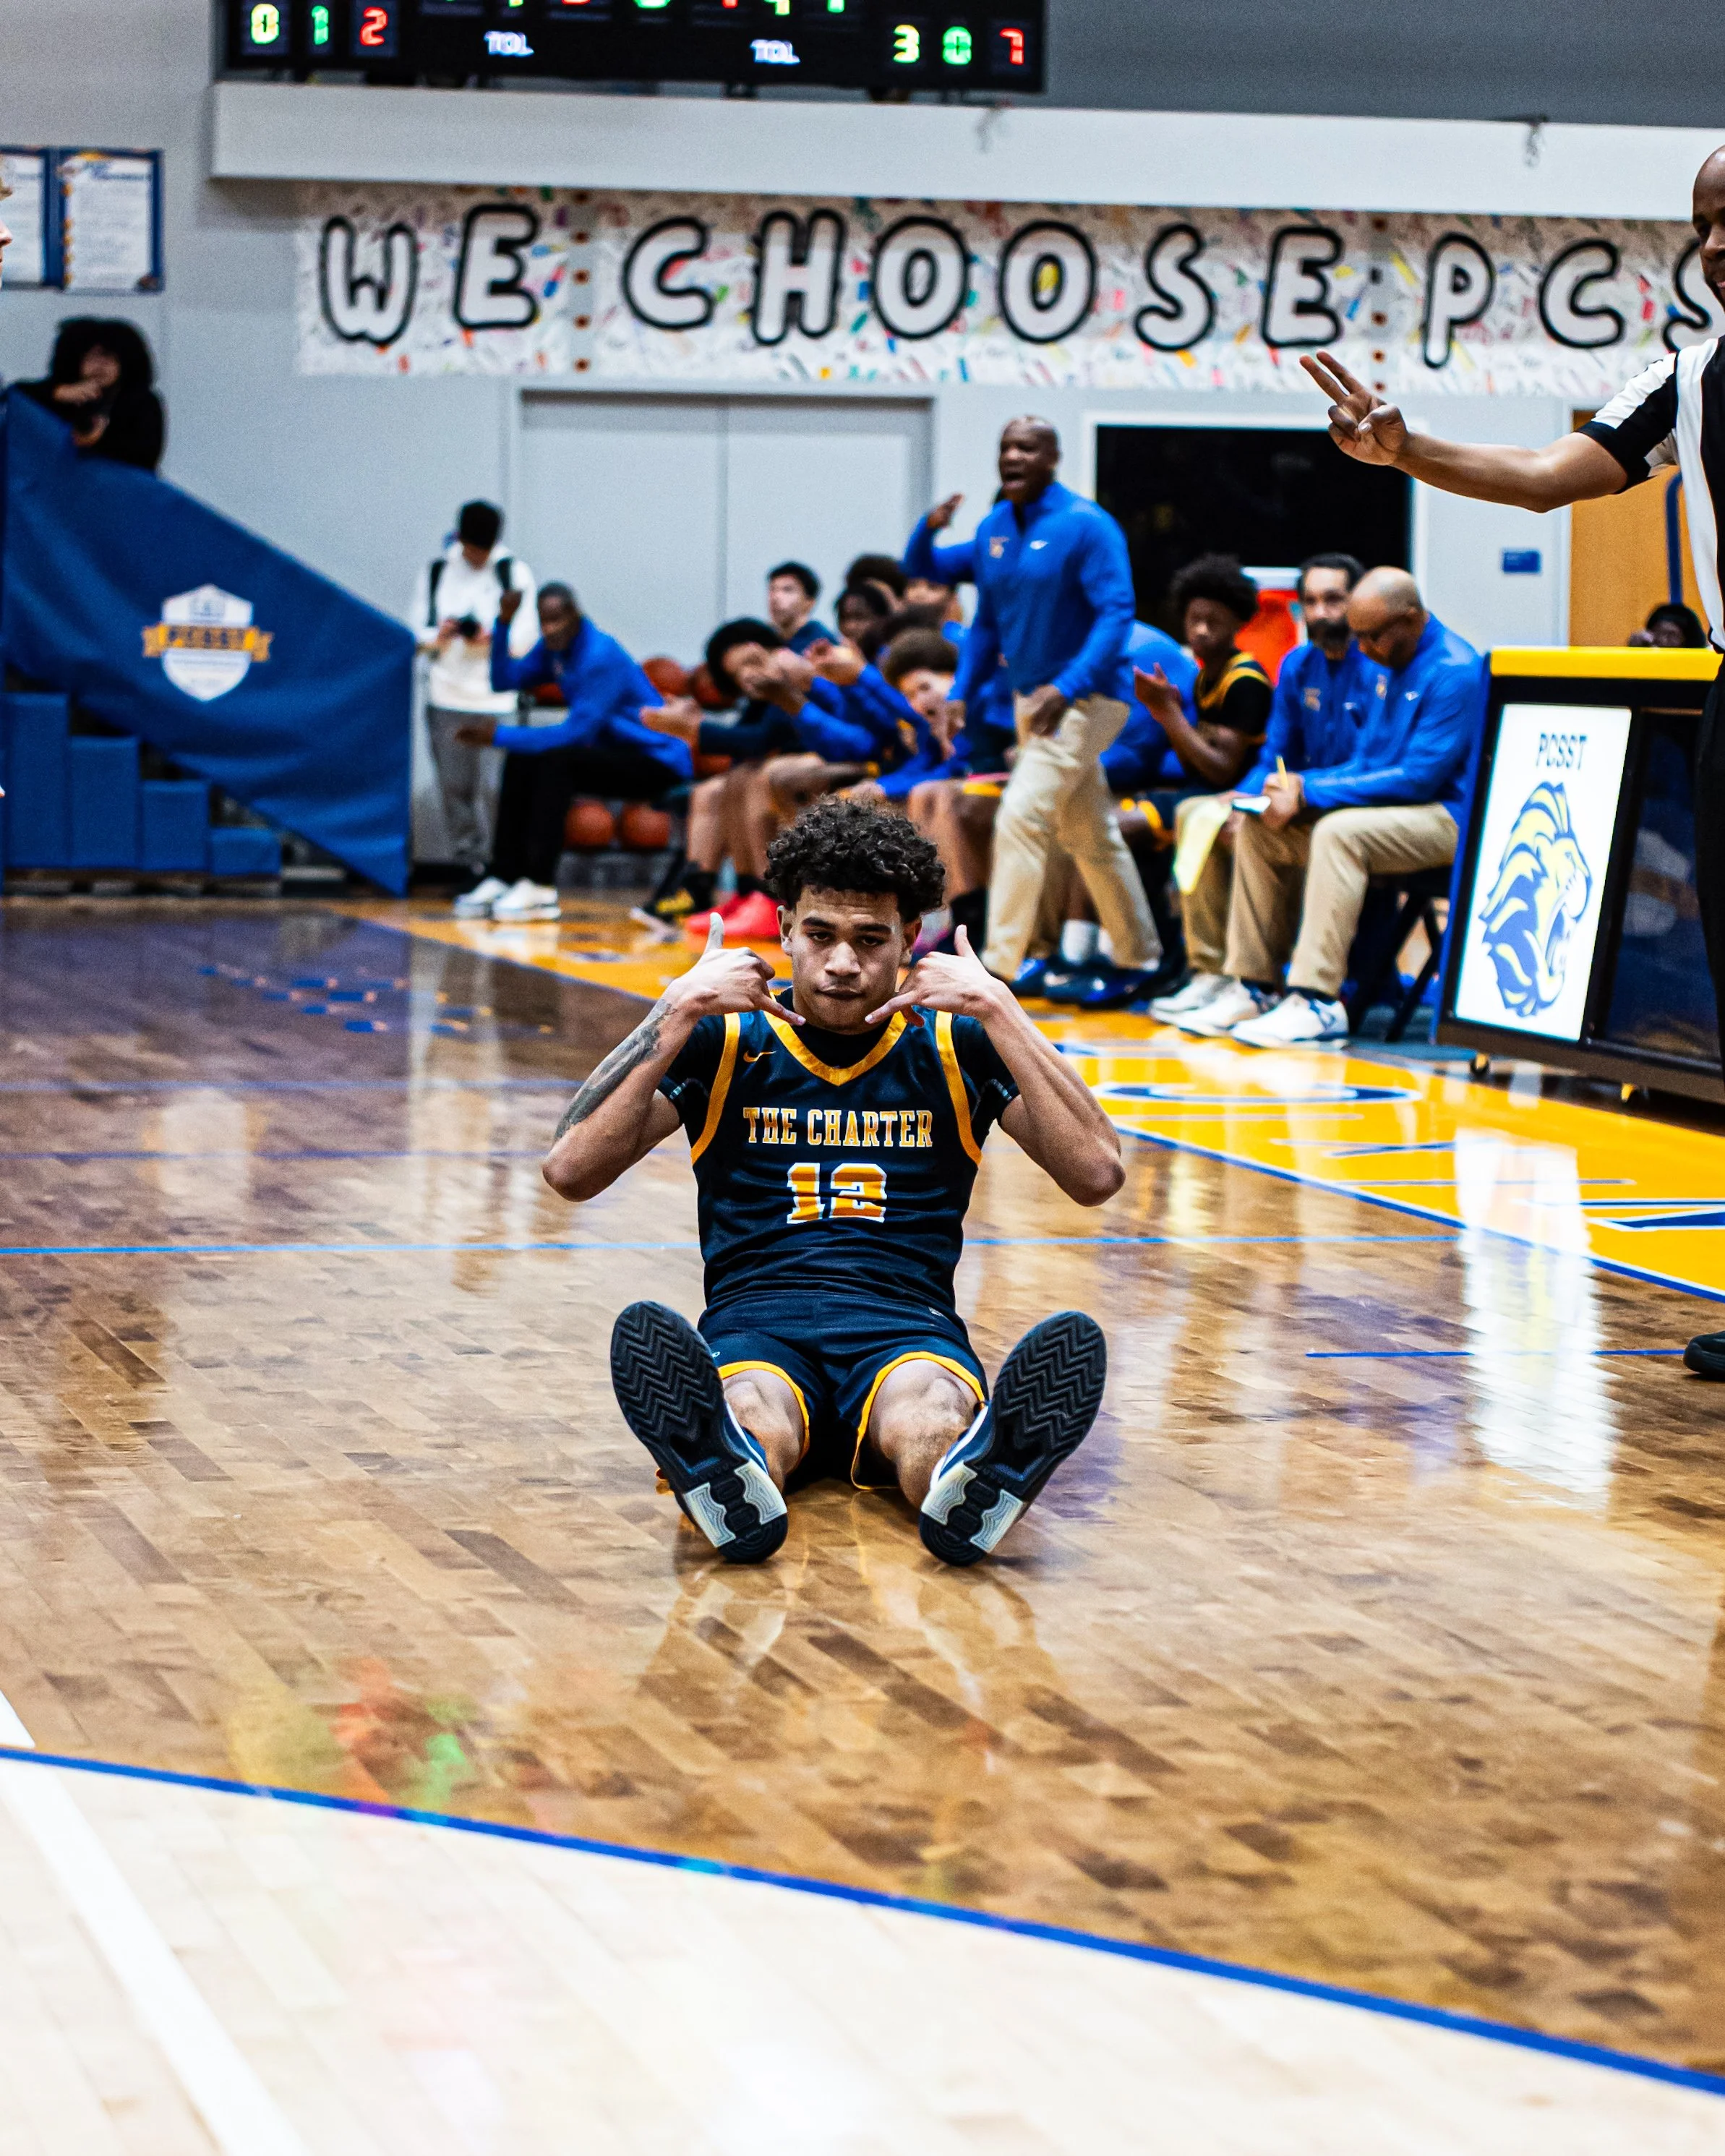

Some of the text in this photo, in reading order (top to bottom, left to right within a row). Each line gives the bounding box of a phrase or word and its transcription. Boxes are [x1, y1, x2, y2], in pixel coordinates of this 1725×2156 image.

[251, 3, 280, 45] 0
[312, 5, 329, 46] 1
[360, 7, 388, 46] 2
[893, 25, 920, 63] 3
[943, 26, 972, 65] 0
[1000, 27, 1024, 64] 7
[319, 203, 540, 347] WE
[620, 209, 1345, 352] CHOOSE
[1536, 732, 1588, 770] PCSST
[742, 1106, 933, 1148] THE CHARTER
[786, 1162, 888, 1224] 12
